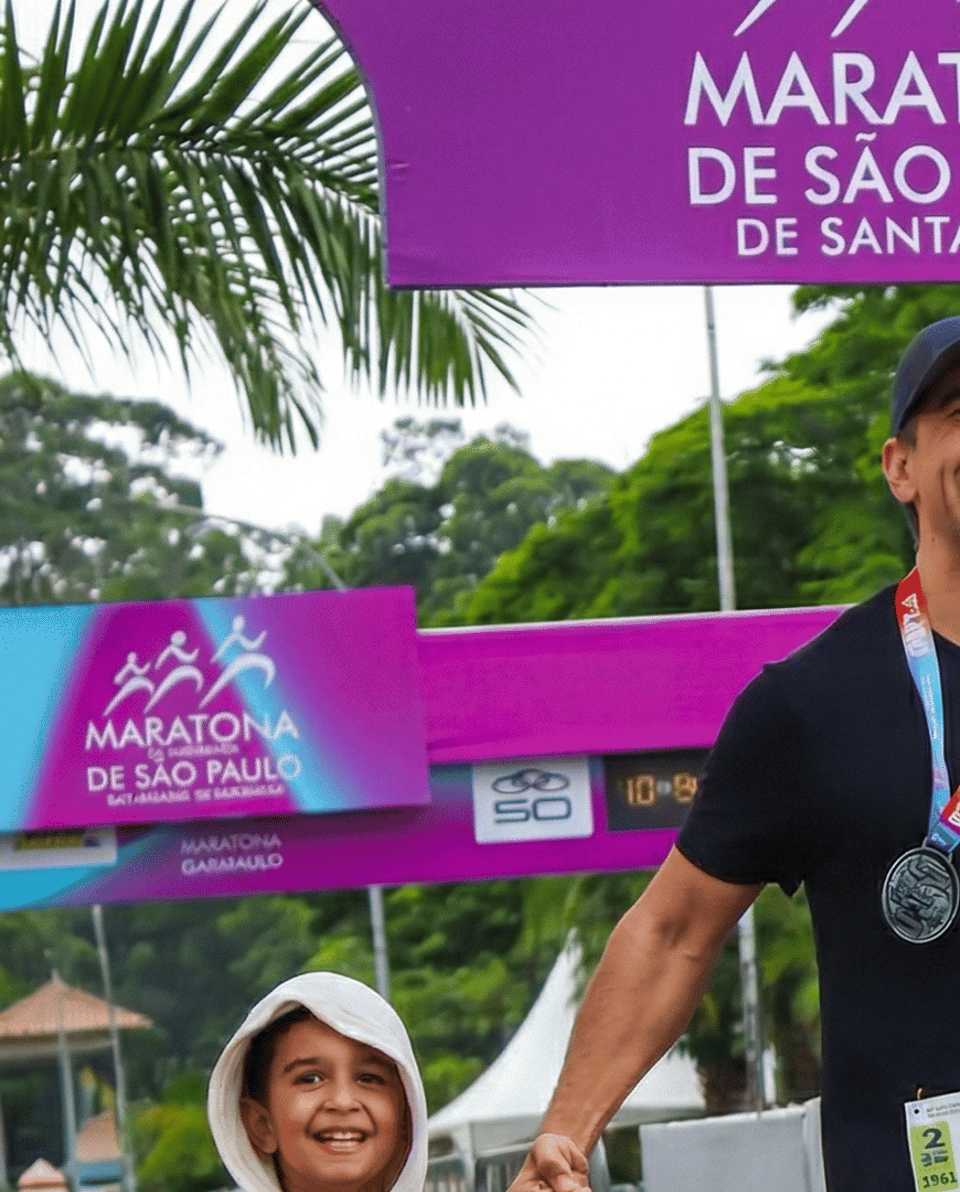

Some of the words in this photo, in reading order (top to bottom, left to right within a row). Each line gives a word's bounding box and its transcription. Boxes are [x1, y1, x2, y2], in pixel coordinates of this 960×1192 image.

[688, 147, 777, 205] DE
[804, 132, 951, 205] SÃO
[736, 217, 798, 256] DE
[85, 710, 299, 750] MARATONA
[87, 765, 125, 791] DE
[206, 753, 301, 785] PAULO
[922, 1128, 946, 1149] 2
[922, 1171, 957, 1189] 1961
